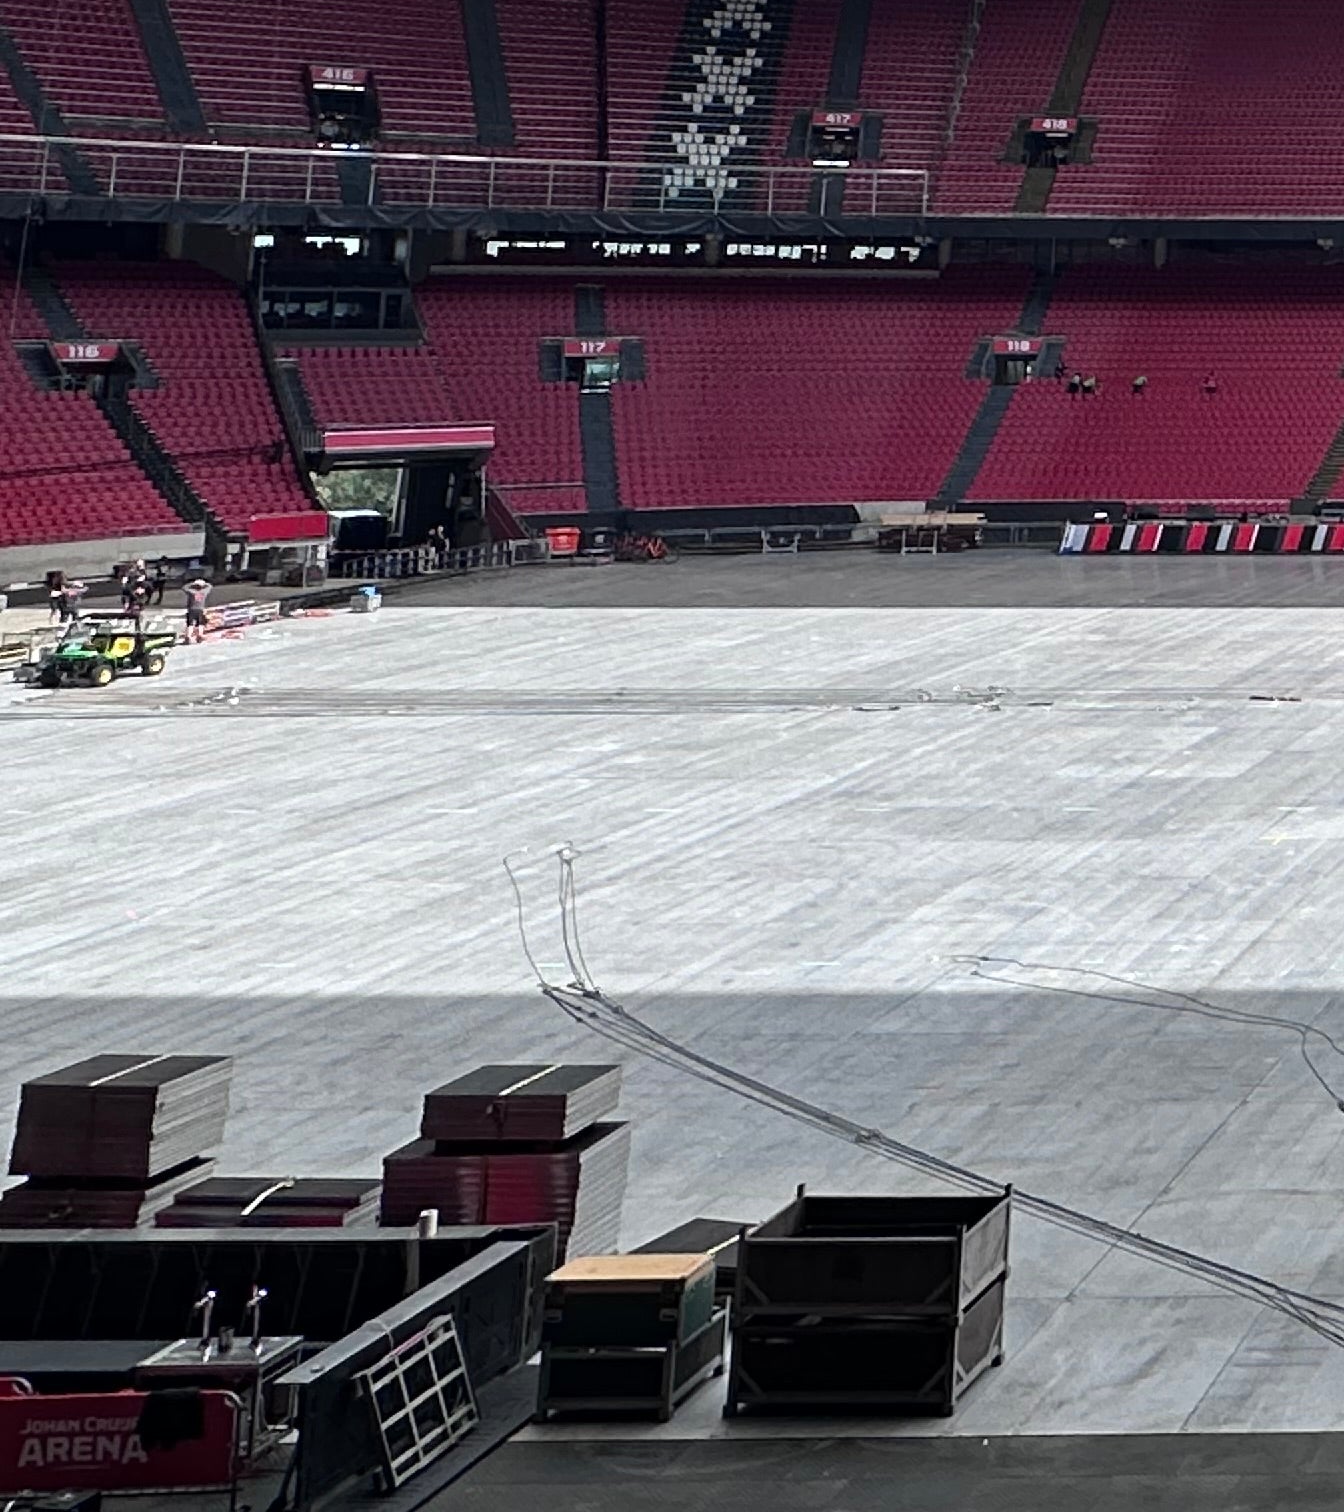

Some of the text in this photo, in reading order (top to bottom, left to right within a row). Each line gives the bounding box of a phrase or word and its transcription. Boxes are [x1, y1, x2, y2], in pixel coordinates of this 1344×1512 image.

[825, 113, 851, 124] 417
[580, 342, 606, 354] 117
[17, 1434, 149, 1467] ARENA
